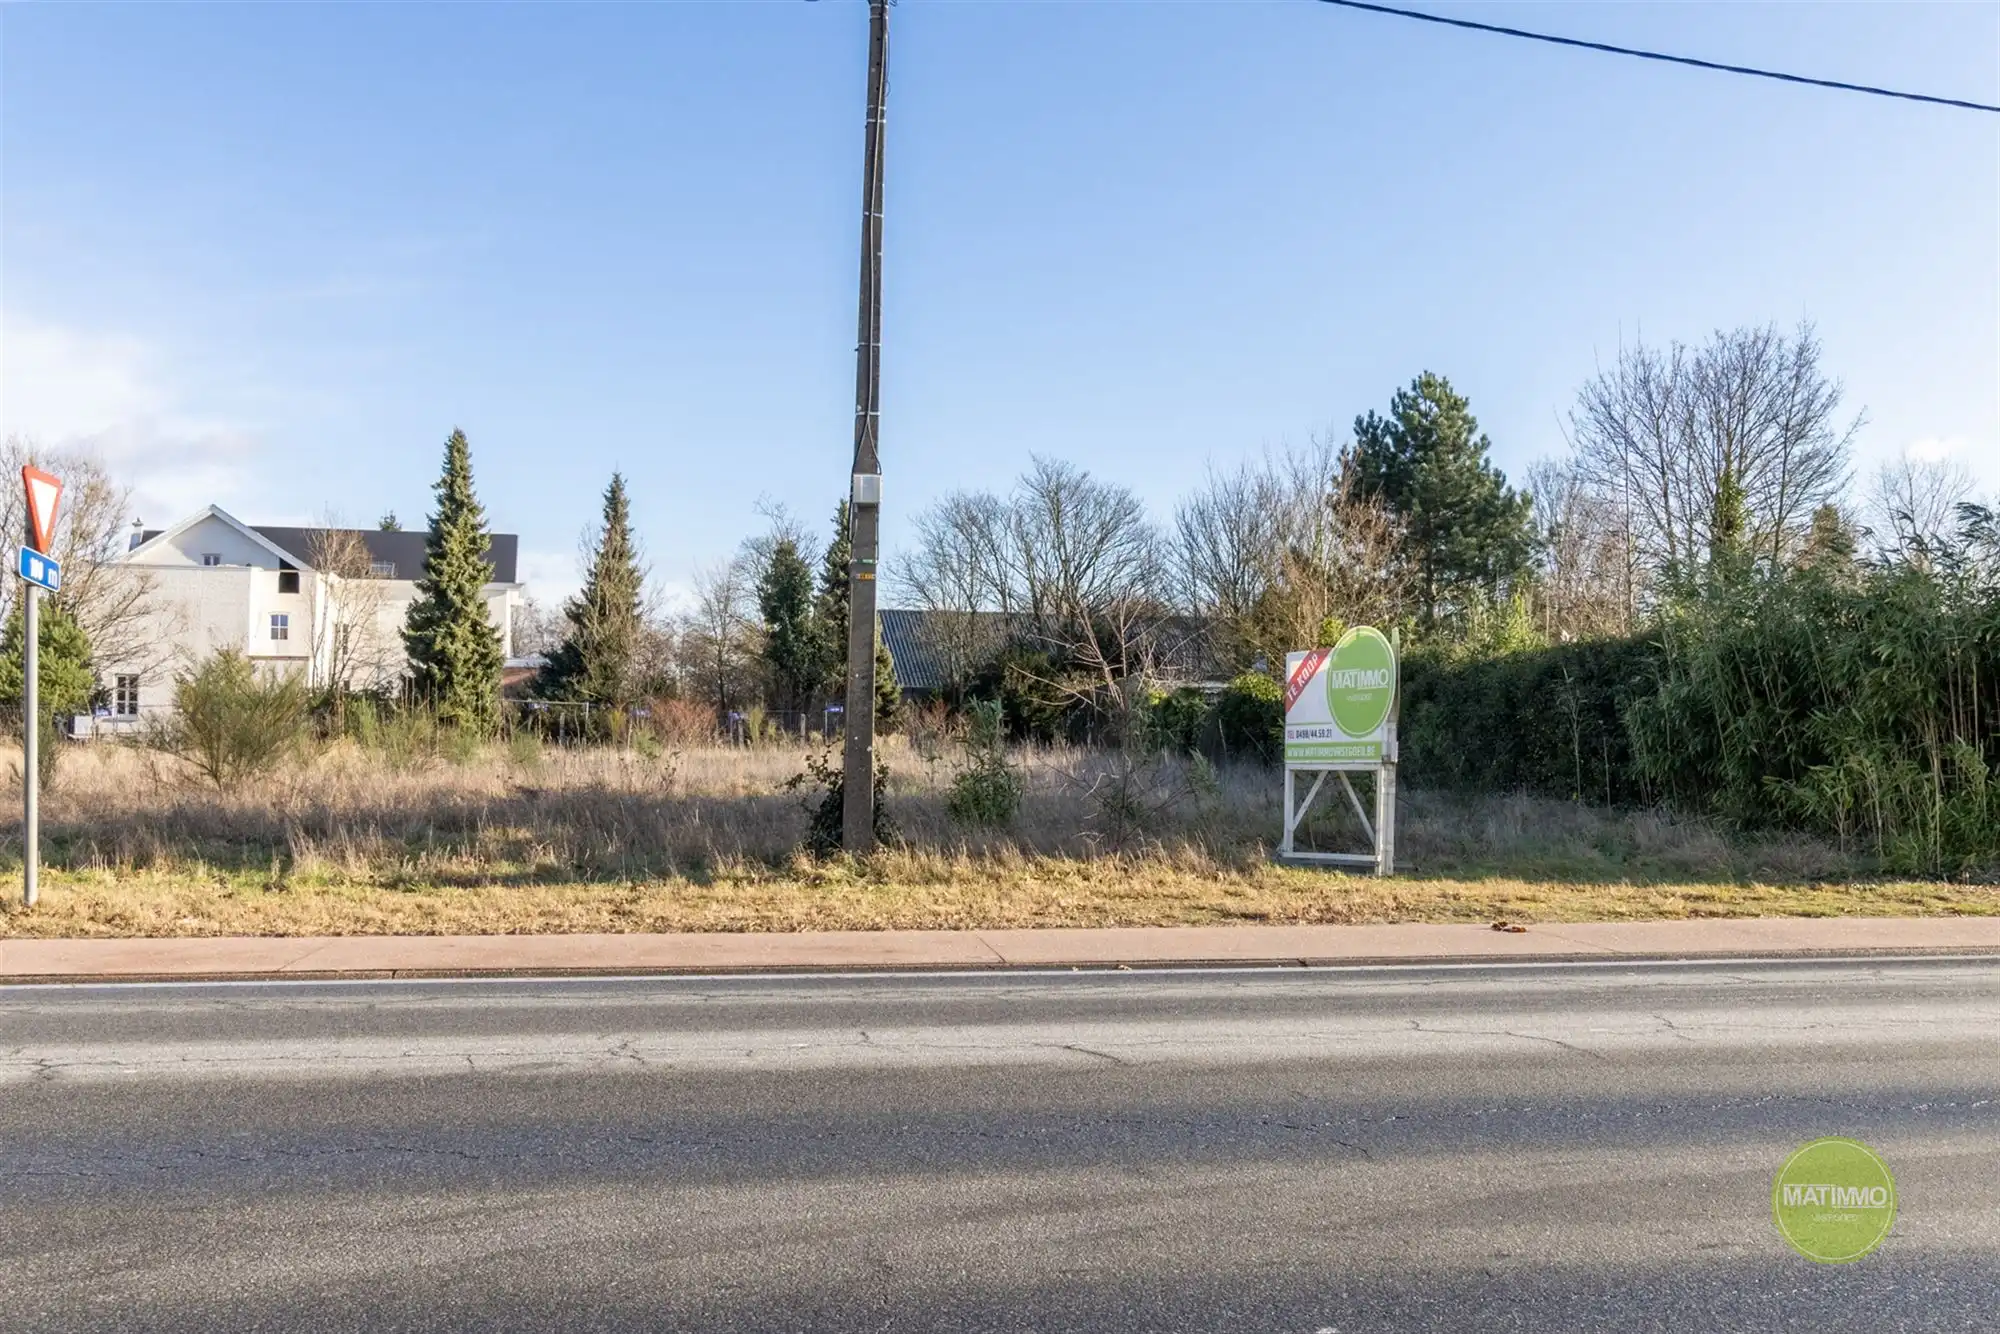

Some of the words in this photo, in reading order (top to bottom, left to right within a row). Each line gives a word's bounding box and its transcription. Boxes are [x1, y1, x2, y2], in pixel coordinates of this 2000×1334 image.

[1287, 686, 1298, 701] TE
[1297, 653, 1318, 688] KOOP
[1332, 669, 1388, 689] MATIMMO
